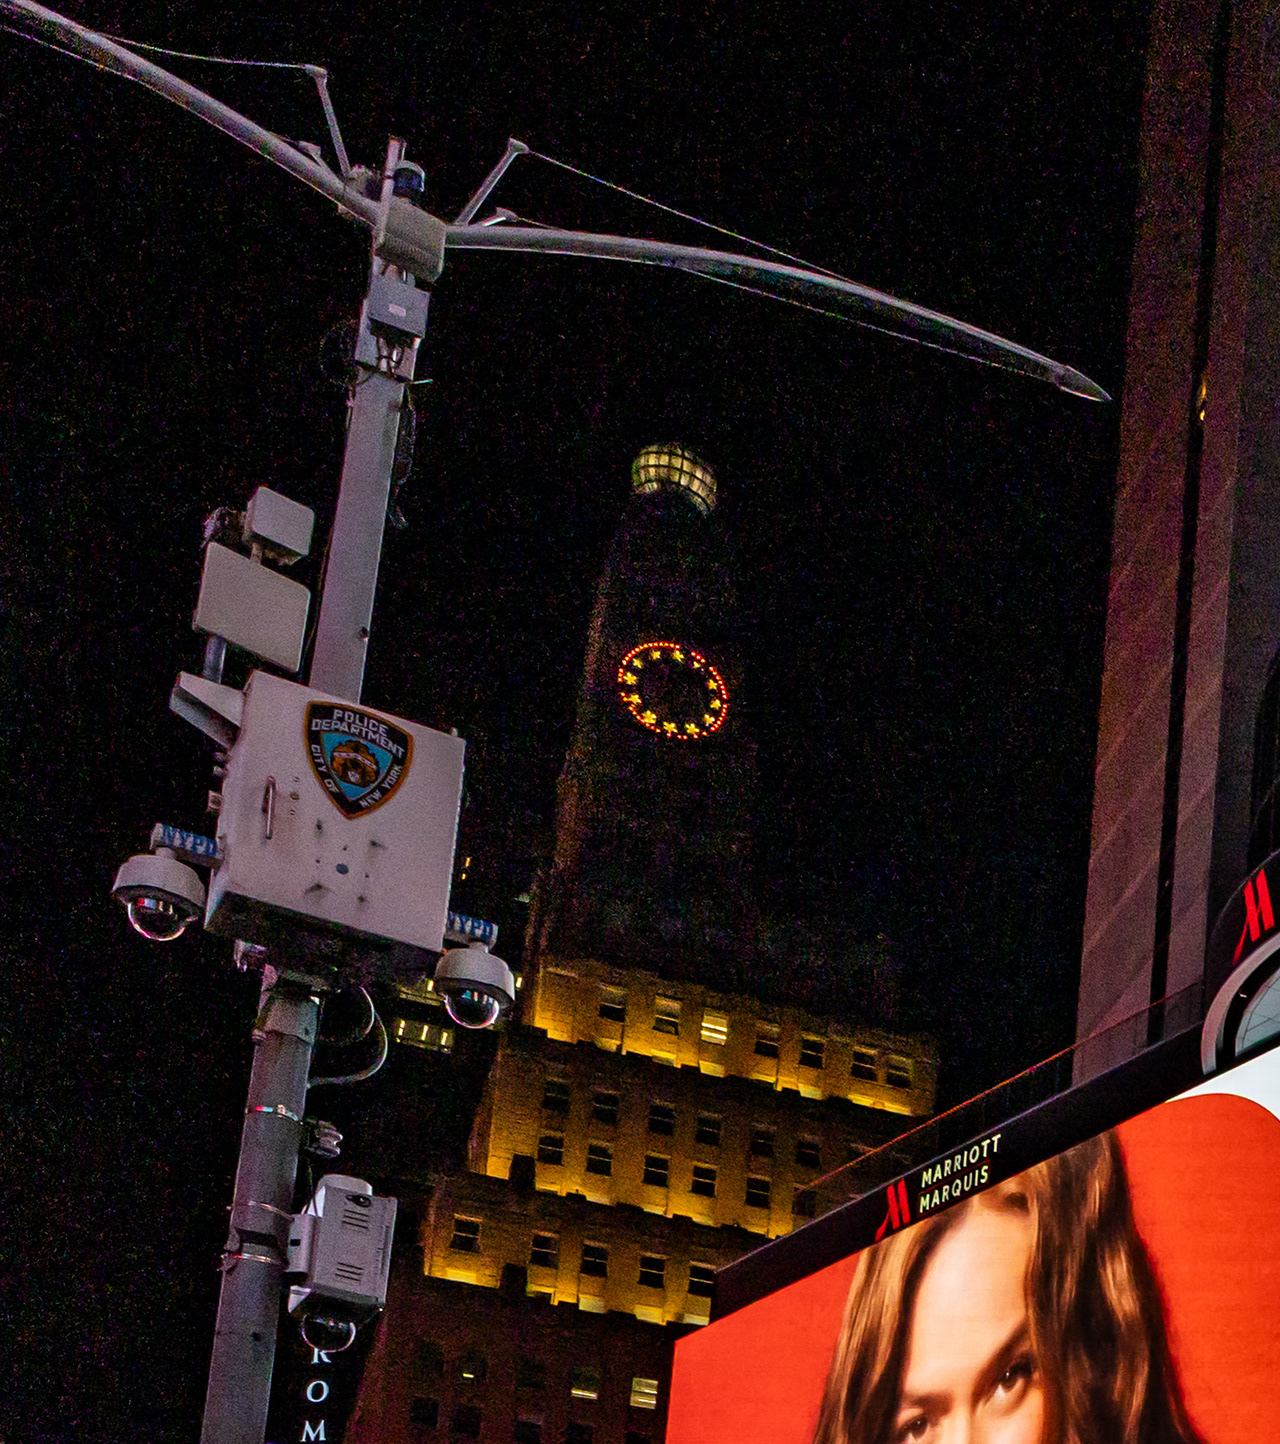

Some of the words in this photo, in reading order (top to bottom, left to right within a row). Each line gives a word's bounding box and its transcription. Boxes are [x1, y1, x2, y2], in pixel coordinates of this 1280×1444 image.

[311, 718, 405, 759] DEPARTMENT
[333, 709, 389, 737] POLICE
[311, 744, 328, 773] CITY
[359, 789, 383, 808] NEW
[382, 765, 403, 789] YORK
[162, 826, 217, 856] NYPD
[920, 1134, 1002, 1188] MARRIOTT
[919, 1165, 989, 1214] MARQUIS
[300, 1348, 332, 1442] ROM
